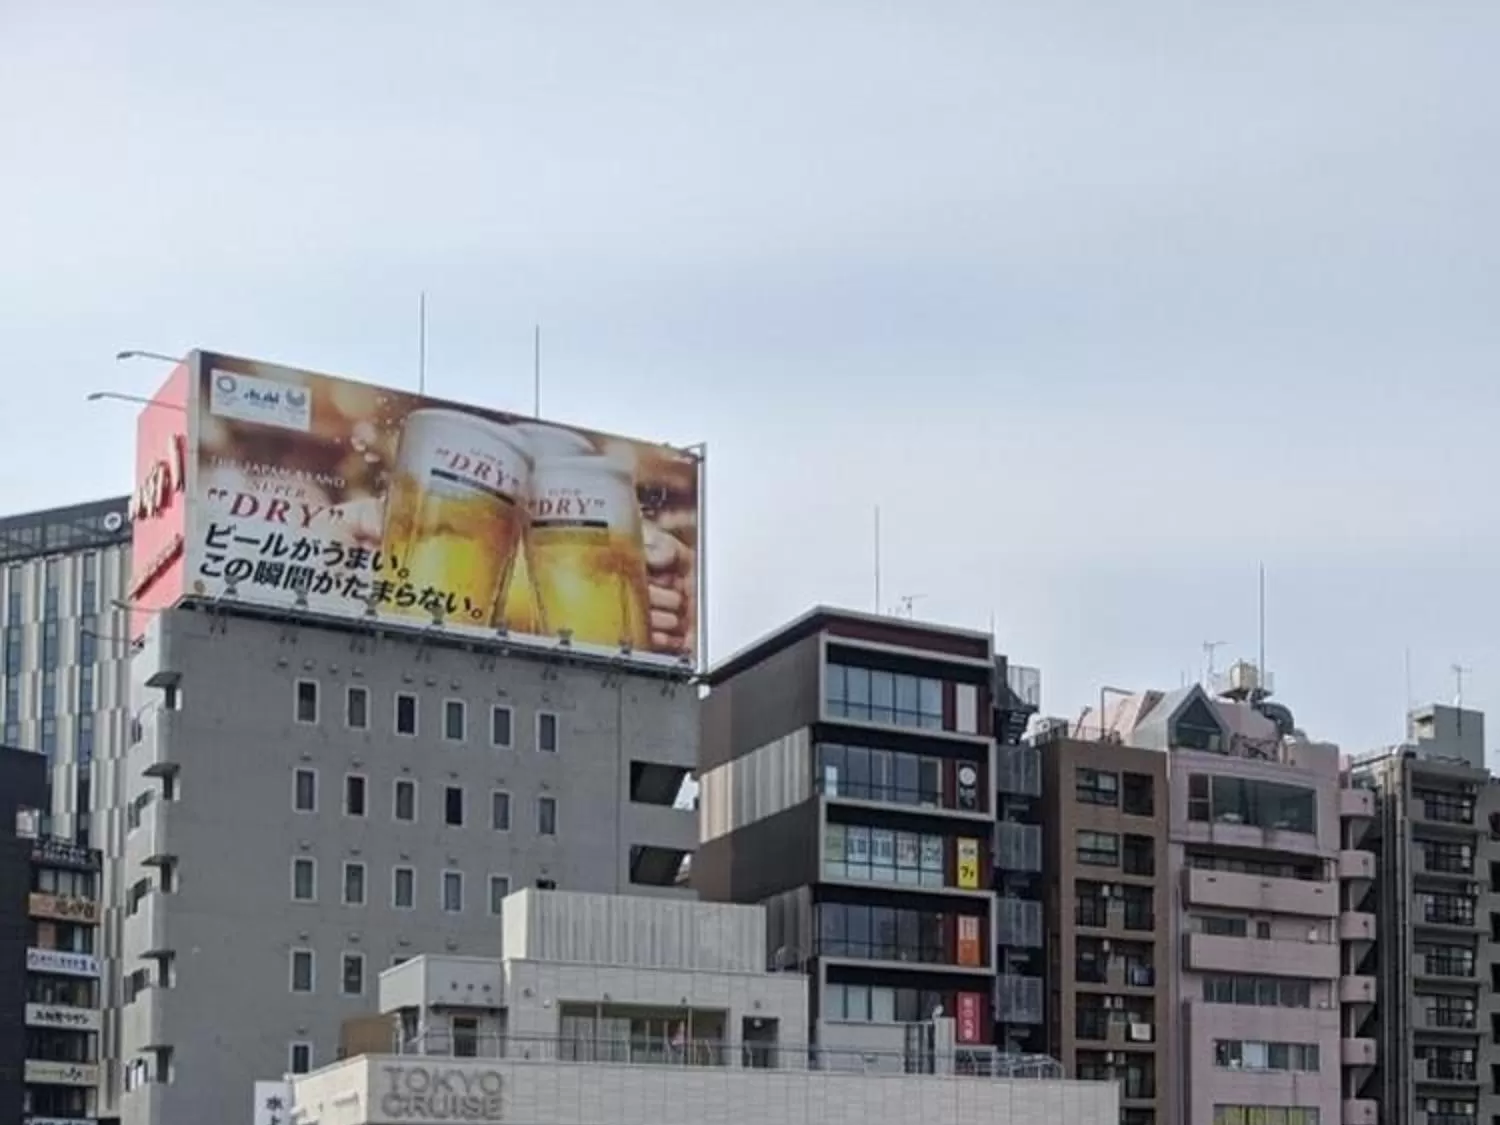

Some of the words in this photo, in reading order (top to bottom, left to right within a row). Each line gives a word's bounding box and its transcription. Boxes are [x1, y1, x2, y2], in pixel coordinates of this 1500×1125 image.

[205, 523, 409, 578] ビールがうまい。
[200, 552, 483, 619] この瞬間がたまらない。
[383, 1066, 502, 1096] TOKYO
[382, 1093, 504, 1120] CRUISE
